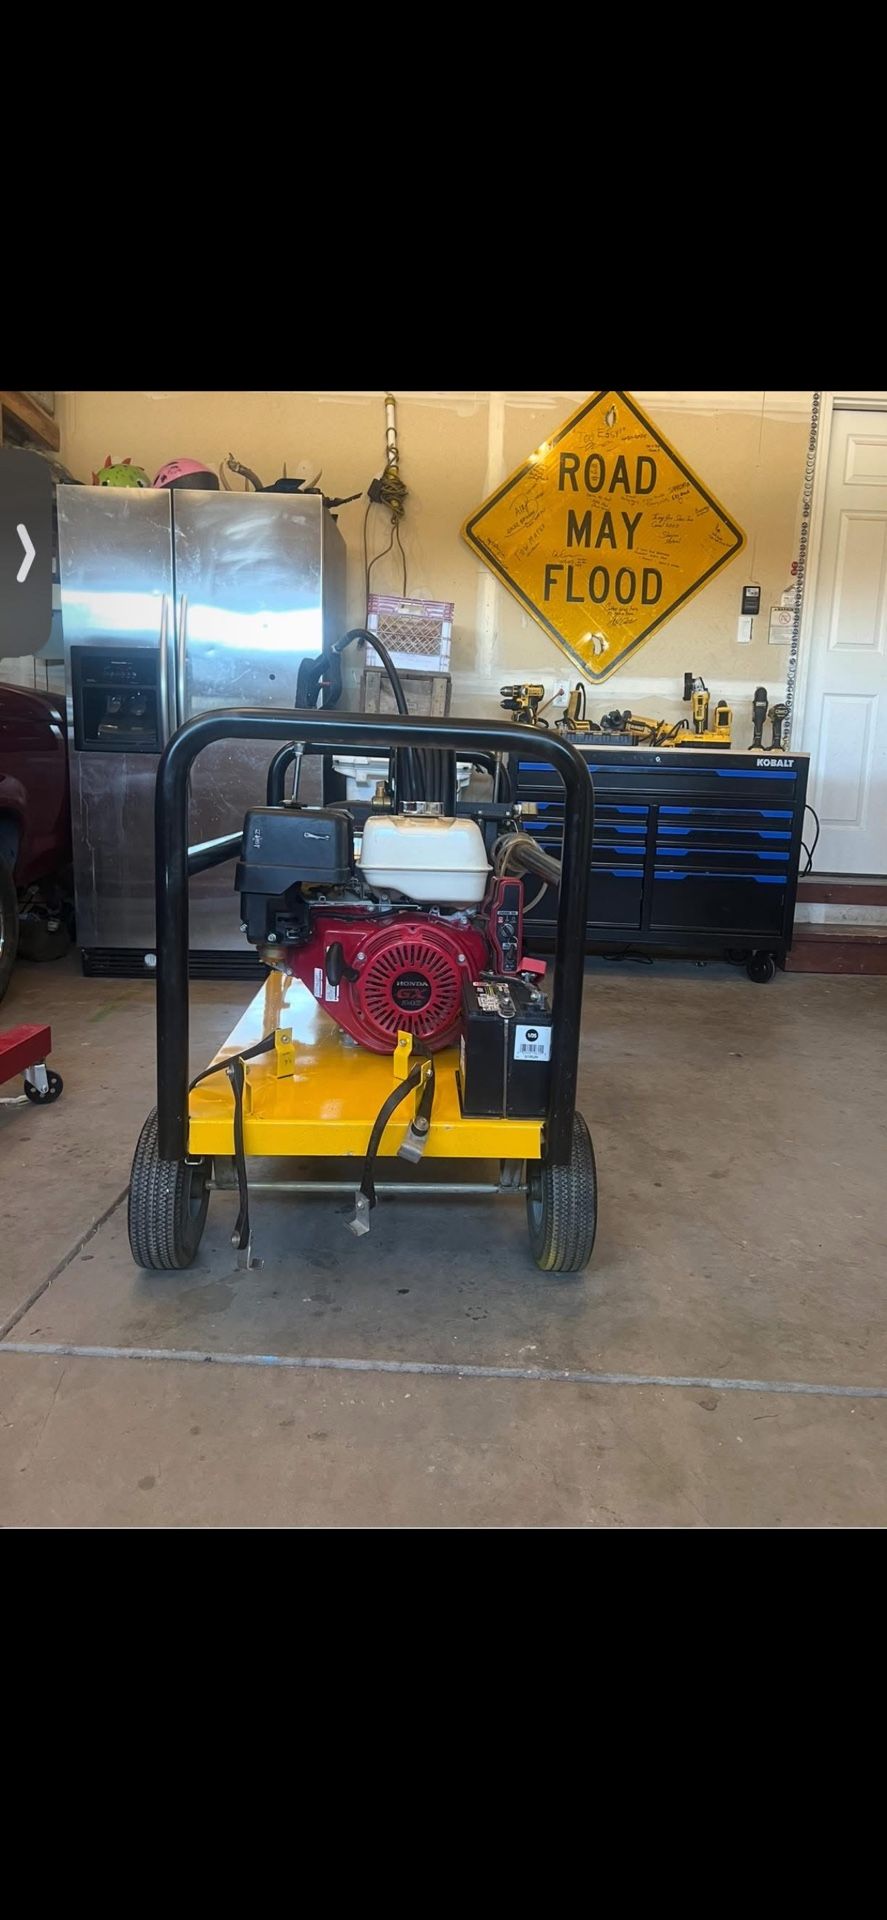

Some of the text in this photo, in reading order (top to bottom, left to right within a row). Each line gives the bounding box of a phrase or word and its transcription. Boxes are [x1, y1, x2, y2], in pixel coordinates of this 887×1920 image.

[558, 452, 658, 495] ROAD
[566, 509, 643, 550] MAY
[543, 563, 663, 605] FLOOD
[756, 758, 795, 768] KOBALT
